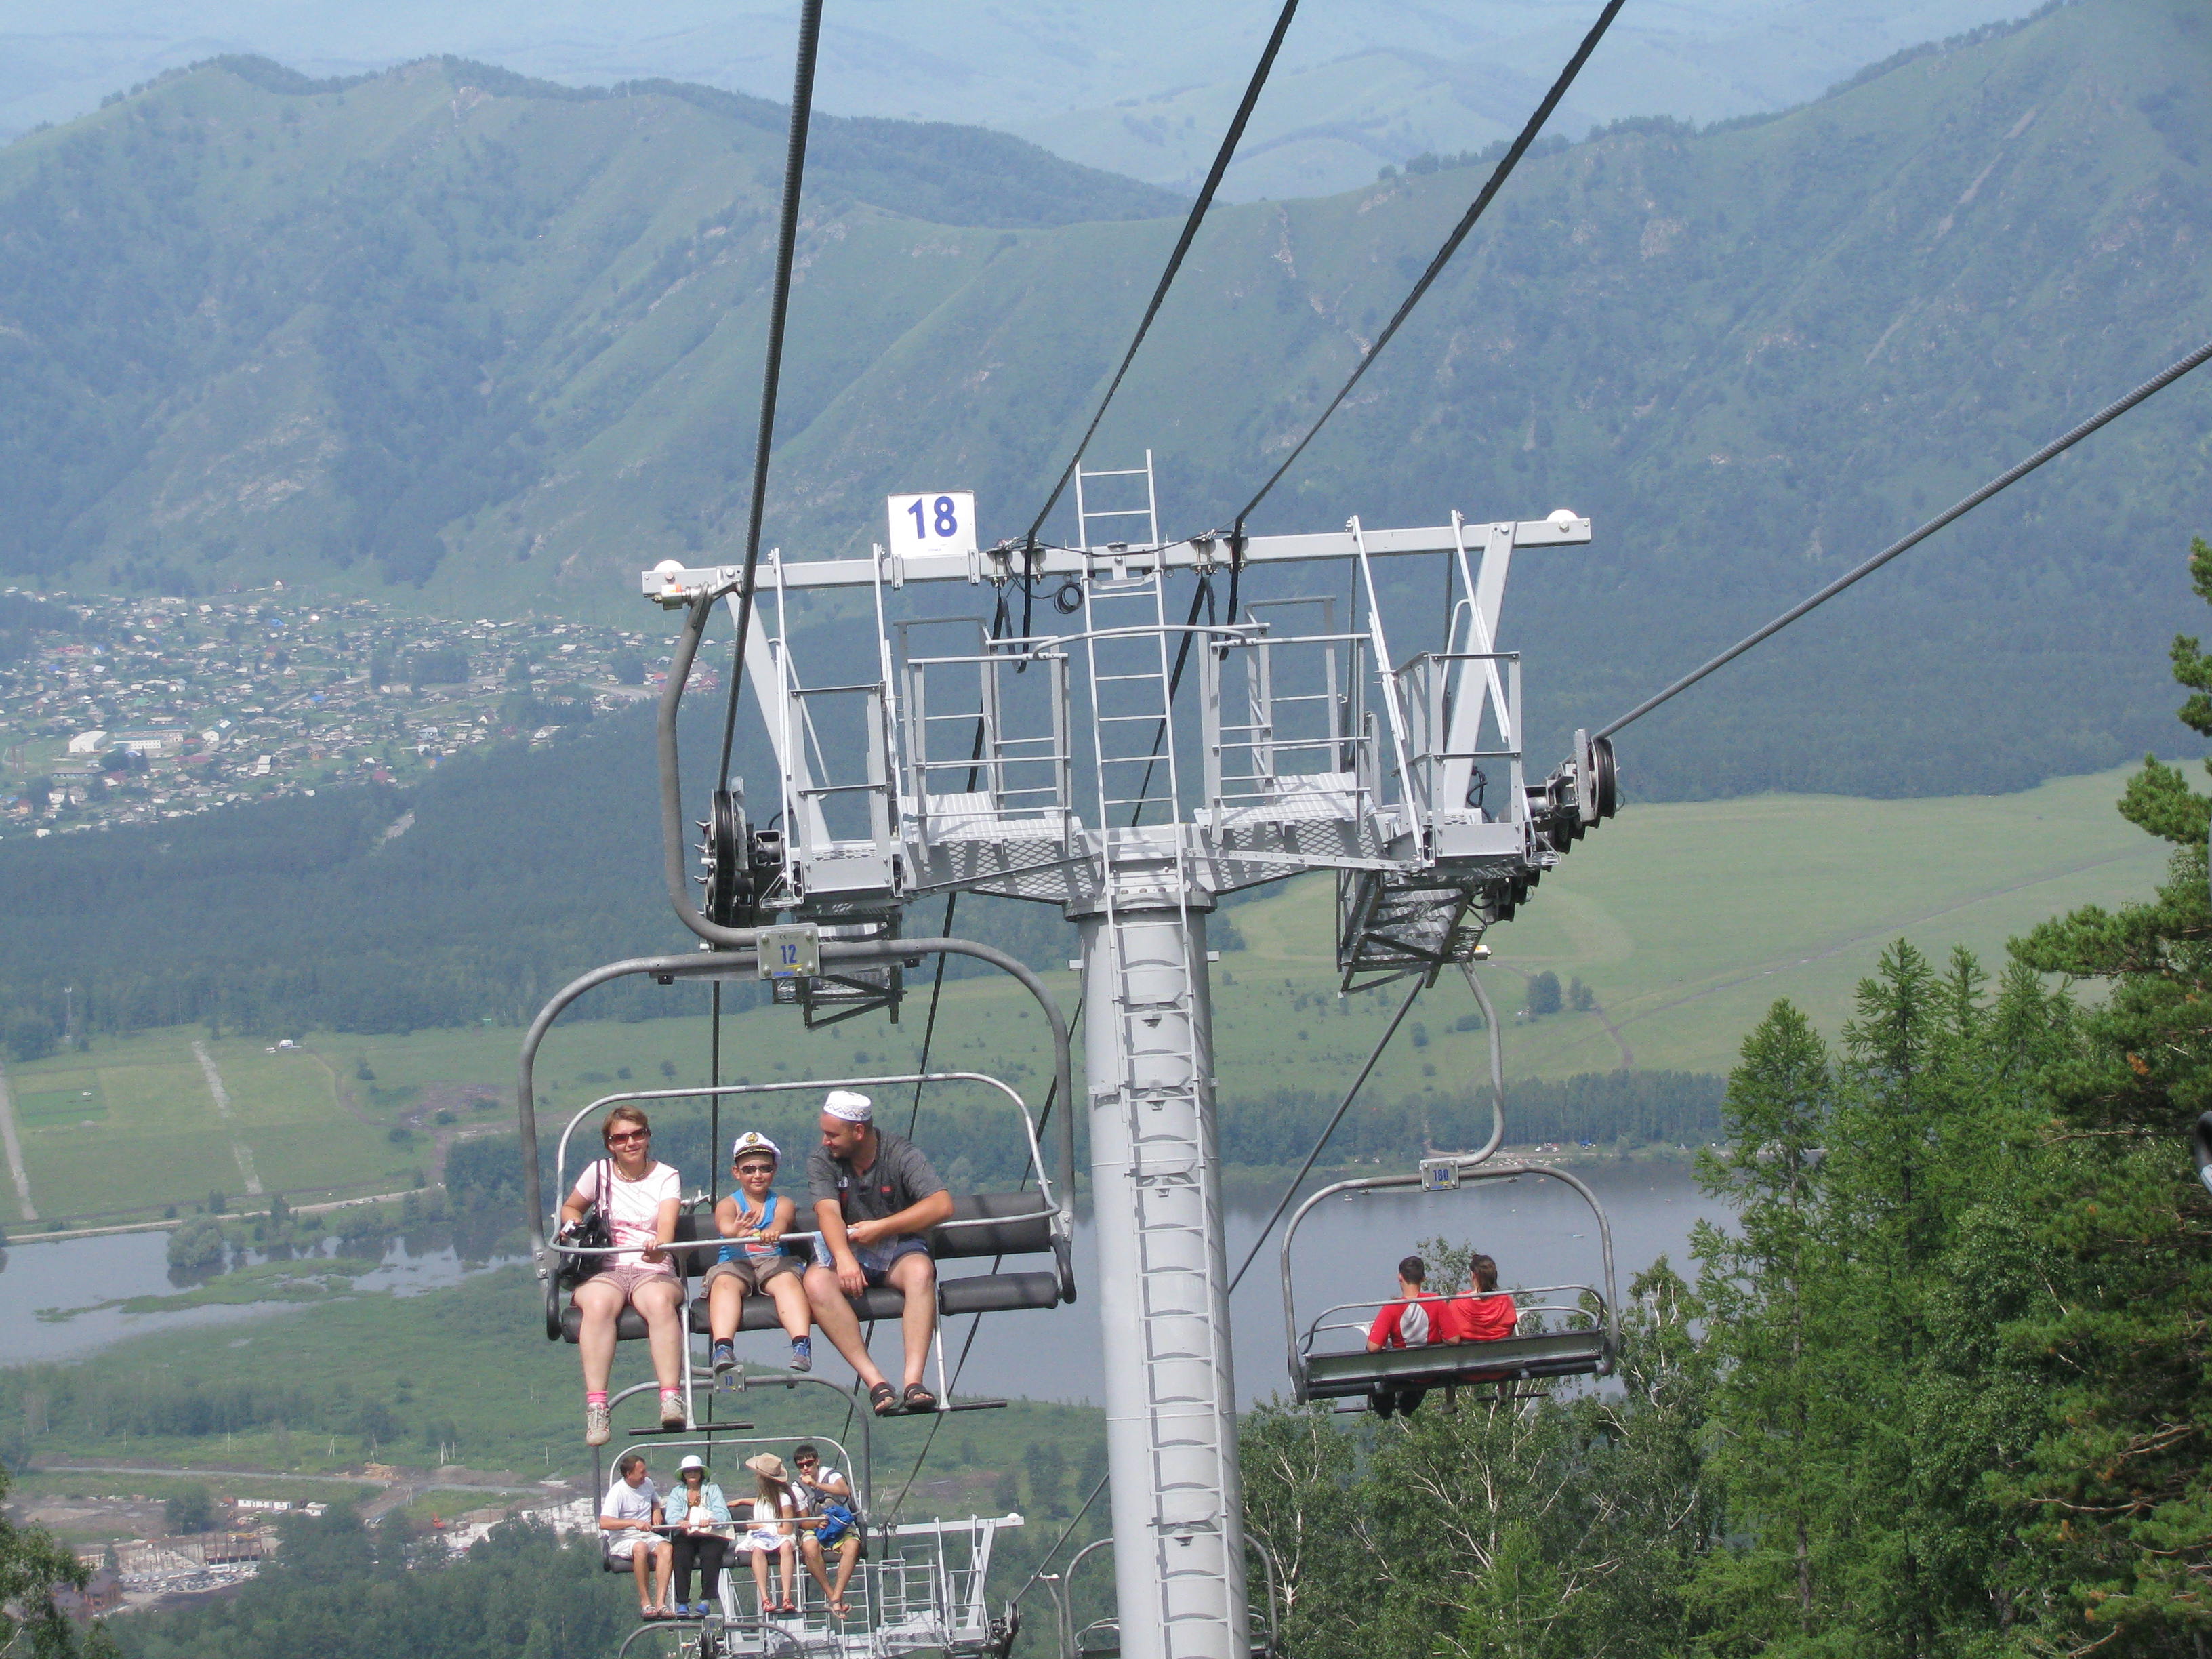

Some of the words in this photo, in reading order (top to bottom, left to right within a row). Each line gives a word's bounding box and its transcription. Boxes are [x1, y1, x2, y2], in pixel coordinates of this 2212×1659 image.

[907, 495, 958, 539] 18
[780, 944, 798, 964] 12
[1433, 1169, 1449, 1181] 180
[725, 1376, 733, 1386] 13
